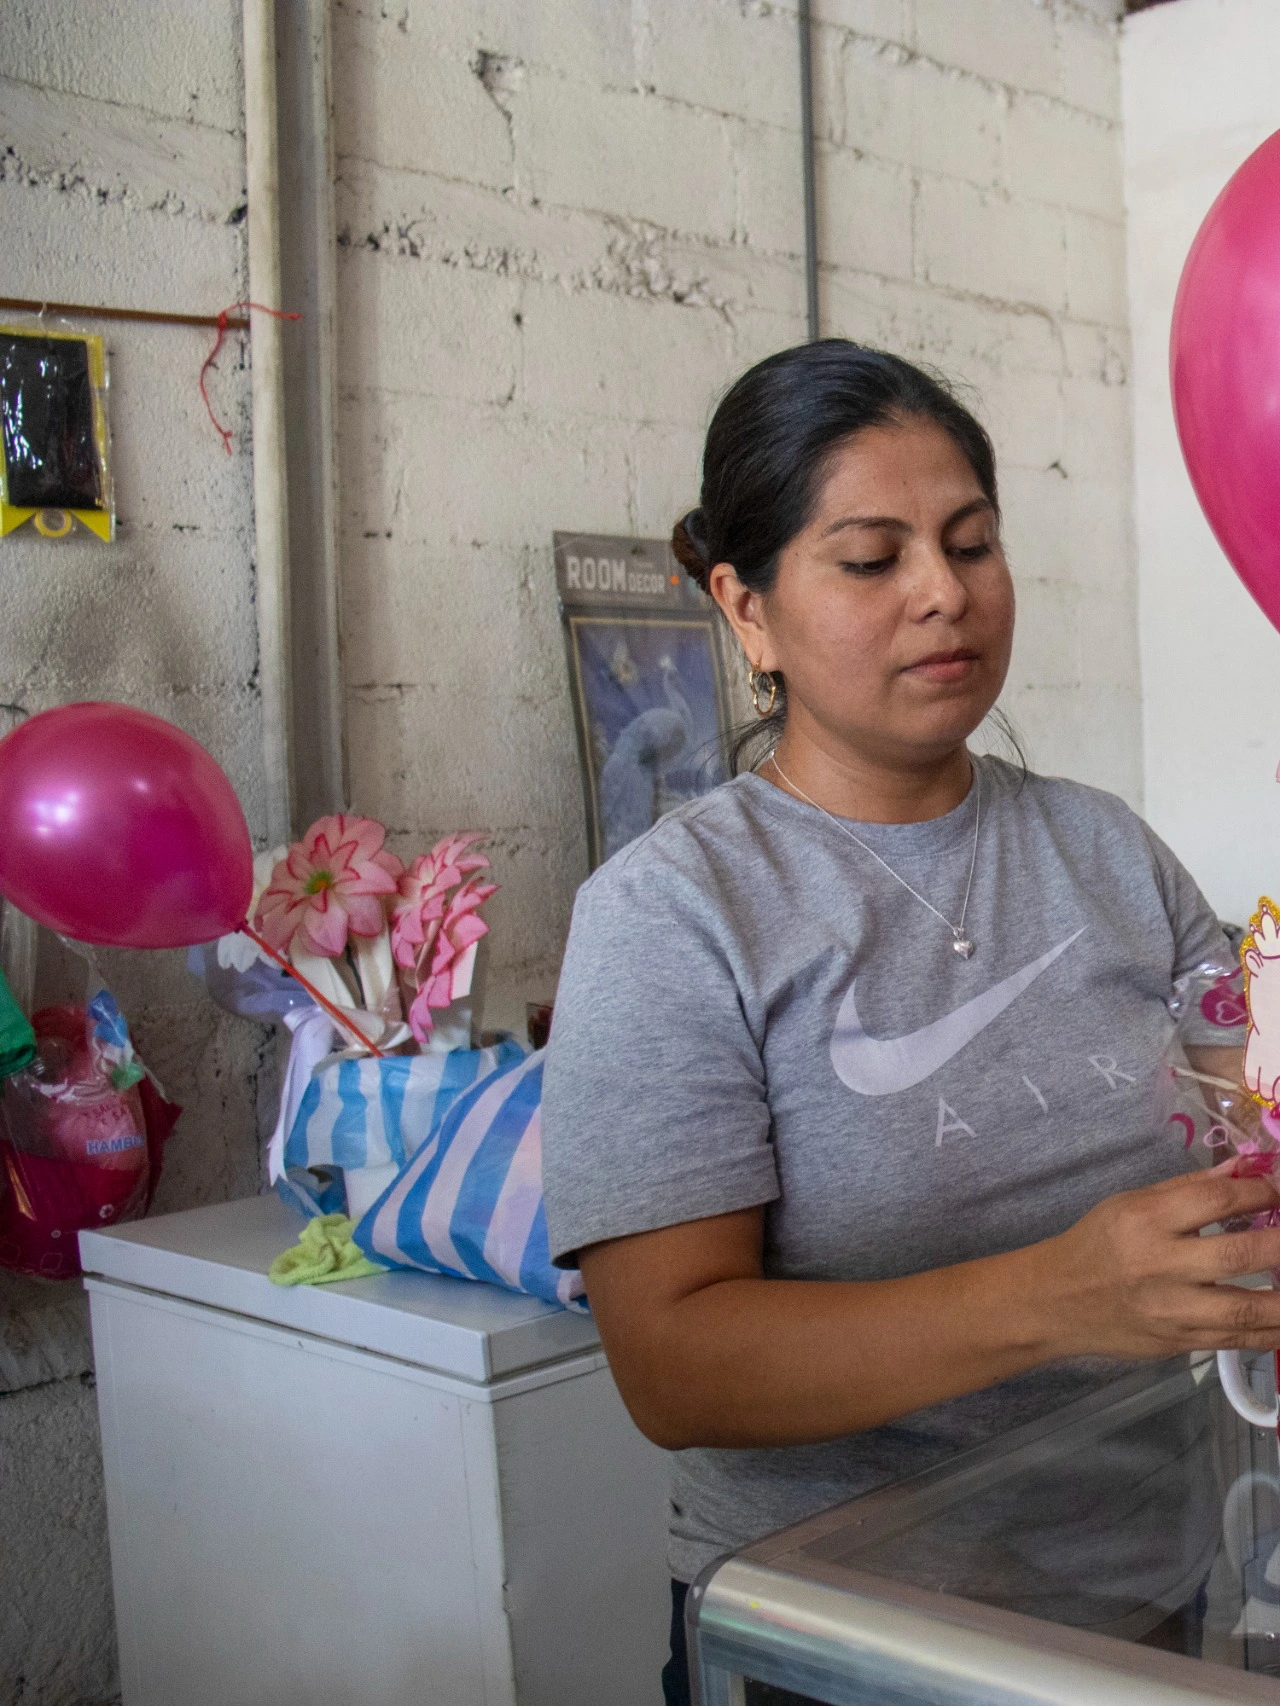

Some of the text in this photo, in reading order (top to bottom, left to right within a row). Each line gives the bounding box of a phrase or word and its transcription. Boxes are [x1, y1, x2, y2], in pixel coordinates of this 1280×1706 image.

[565, 555, 666, 594] ROOM DECOR
[934, 1054, 1137, 1148] AIR
